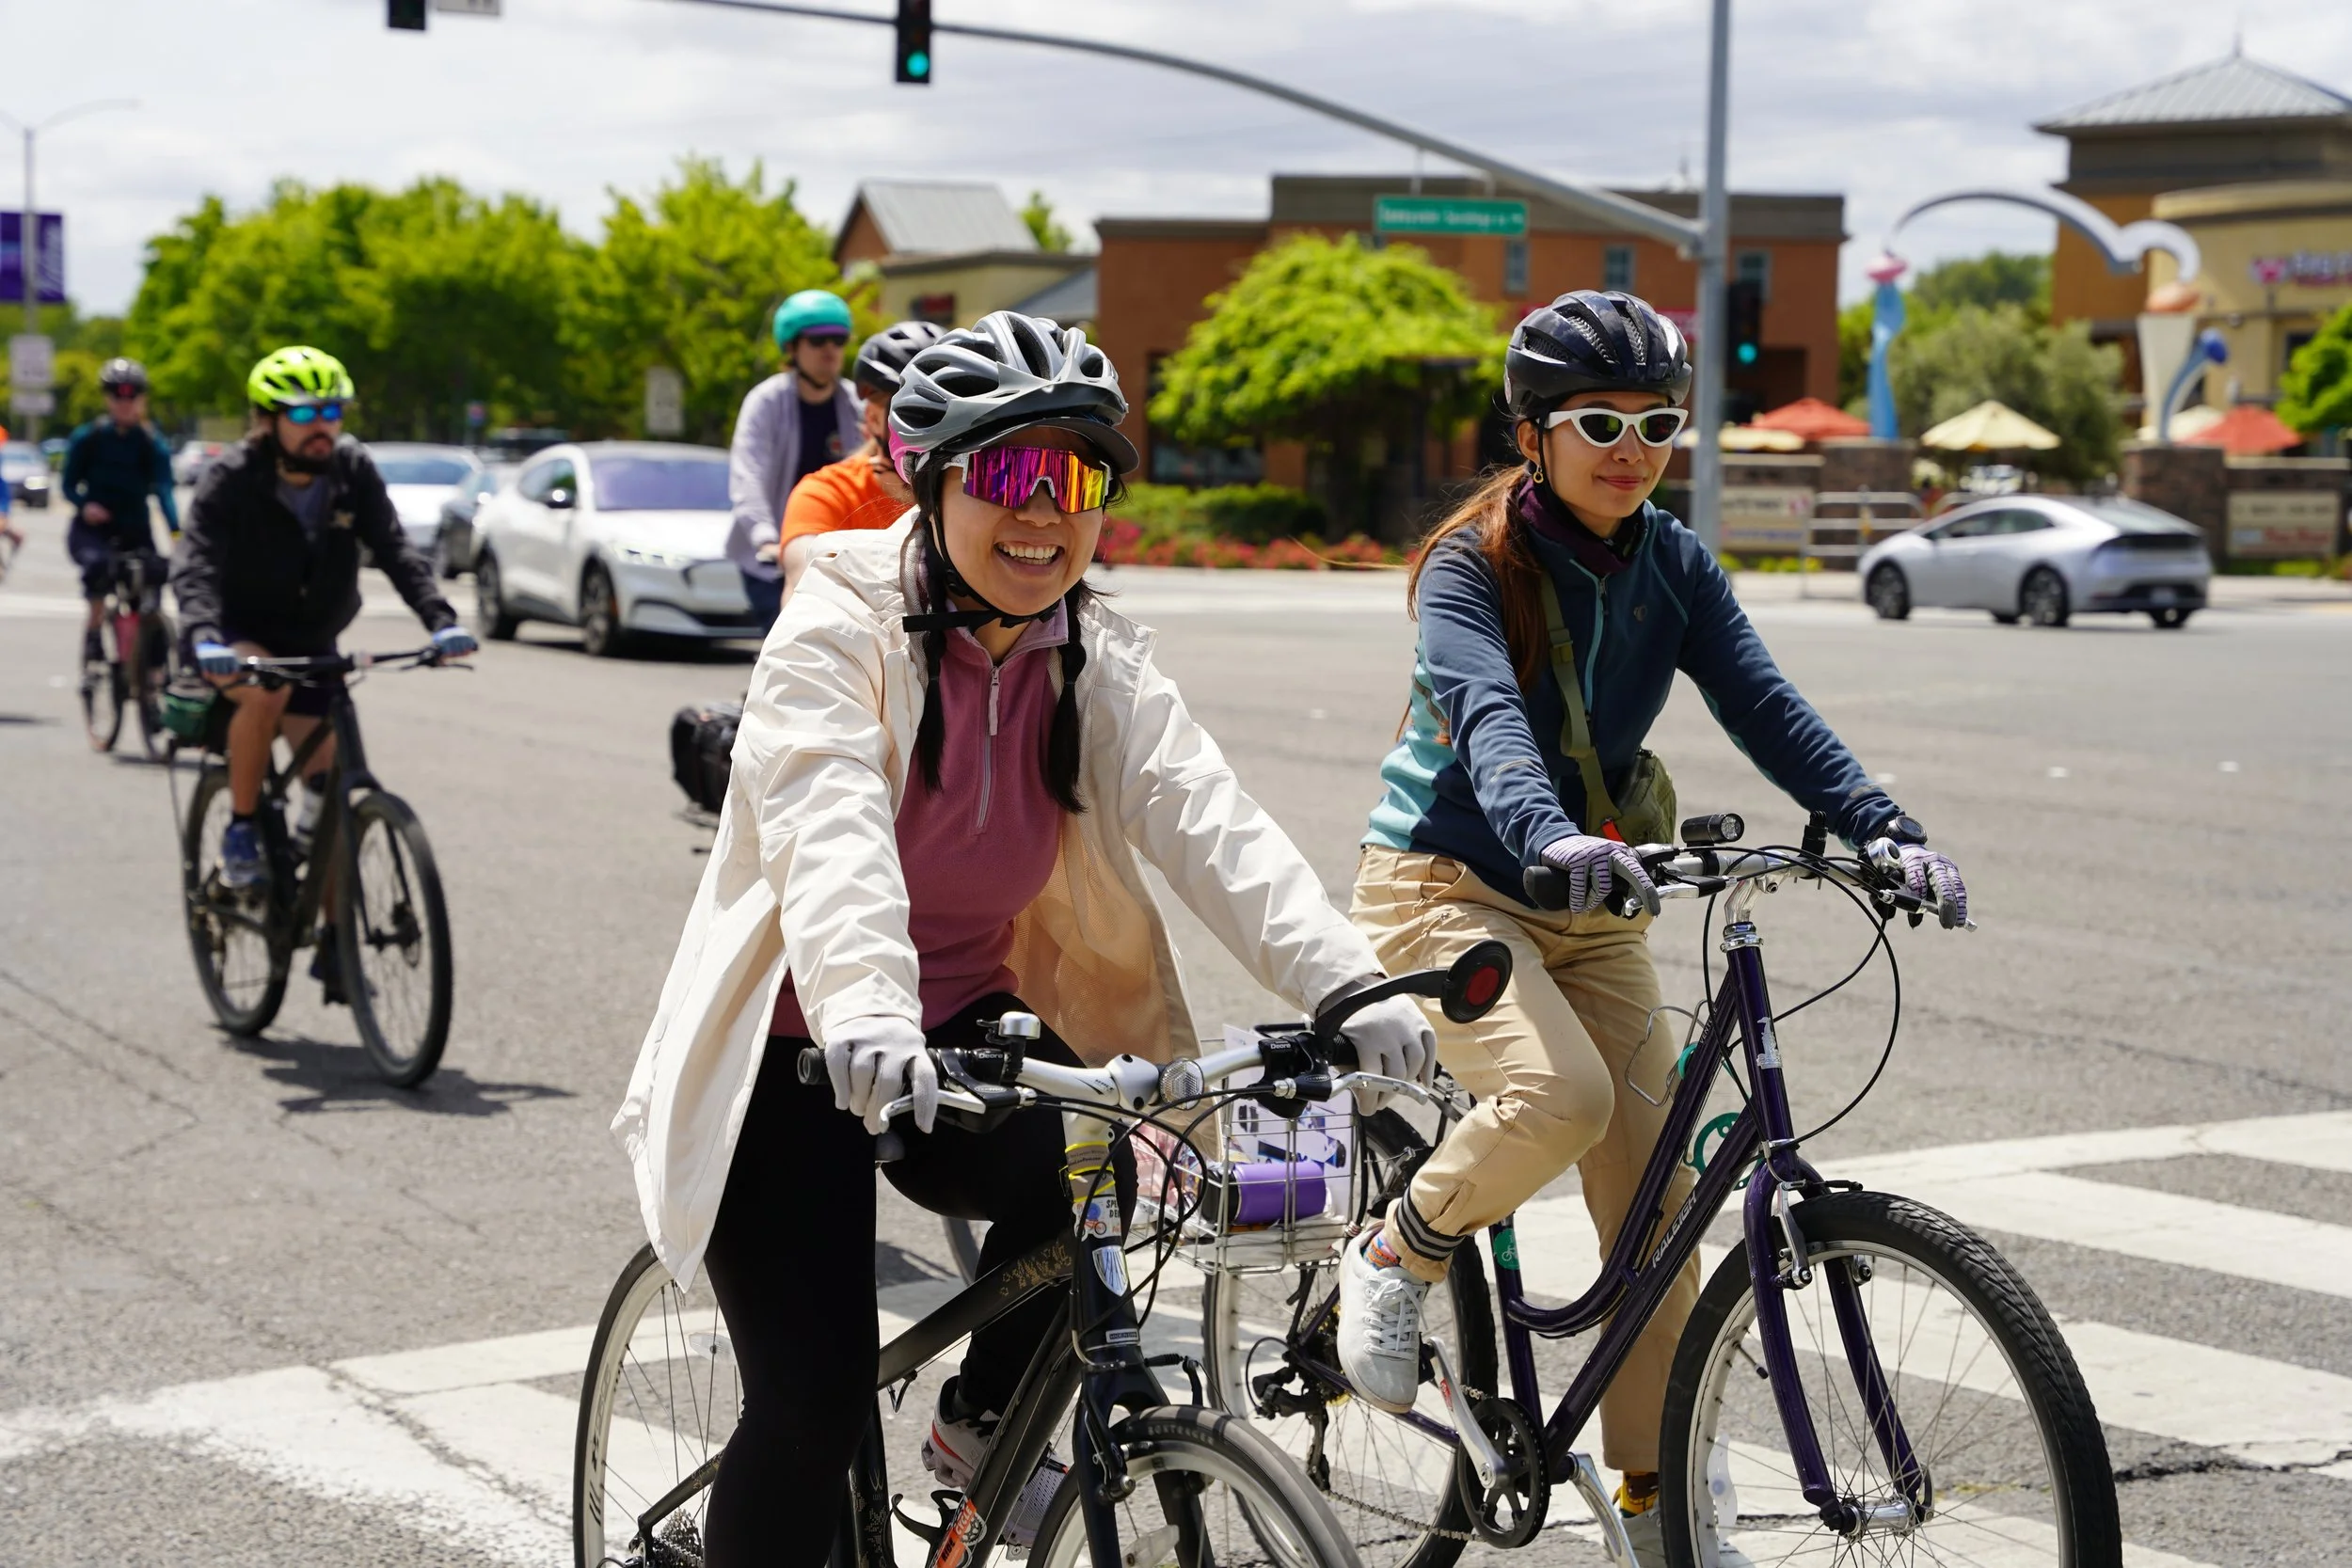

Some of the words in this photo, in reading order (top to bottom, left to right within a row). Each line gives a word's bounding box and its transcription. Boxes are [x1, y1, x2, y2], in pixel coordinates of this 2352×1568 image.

[1270, 1041, 1292, 1050] Deore
[1652, 1189, 1697, 1269] RALEIGH
[955, 1505, 973, 1535] CYCLE
